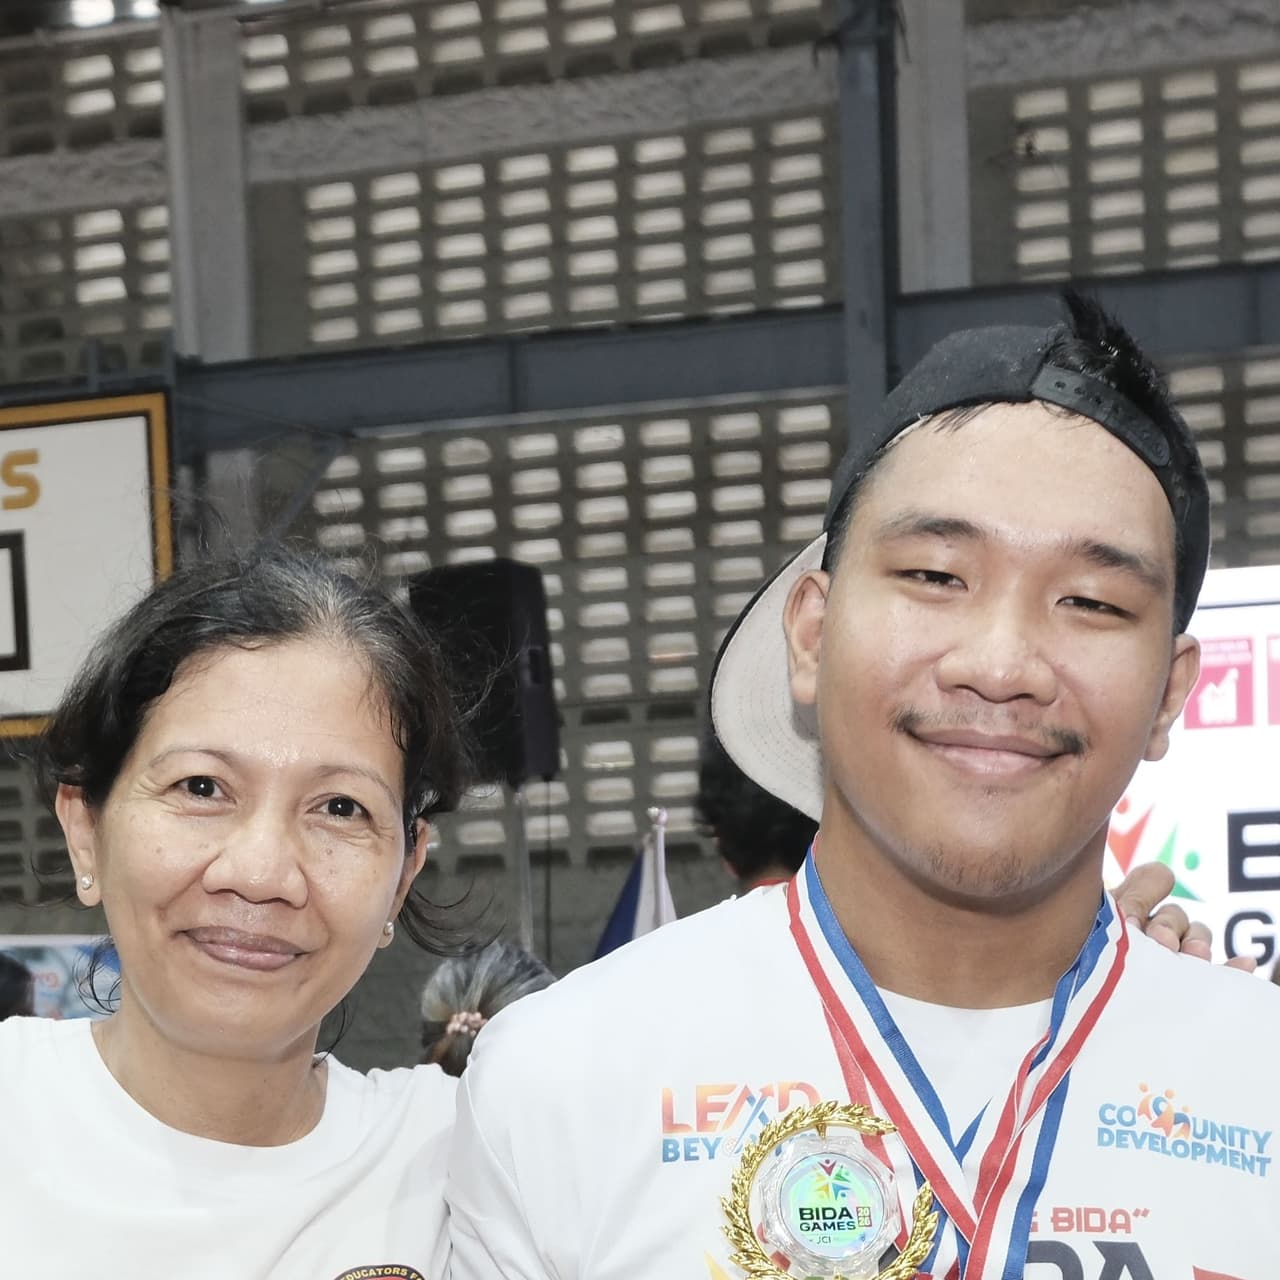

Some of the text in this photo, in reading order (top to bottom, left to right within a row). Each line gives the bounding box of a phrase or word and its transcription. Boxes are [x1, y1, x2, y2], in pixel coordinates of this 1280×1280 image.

[1097, 1127, 1271, 1177] DEVELOPMENT
[799, 1206, 853, 1221] BIDA
[799, 1220, 856, 1232] GAMES
